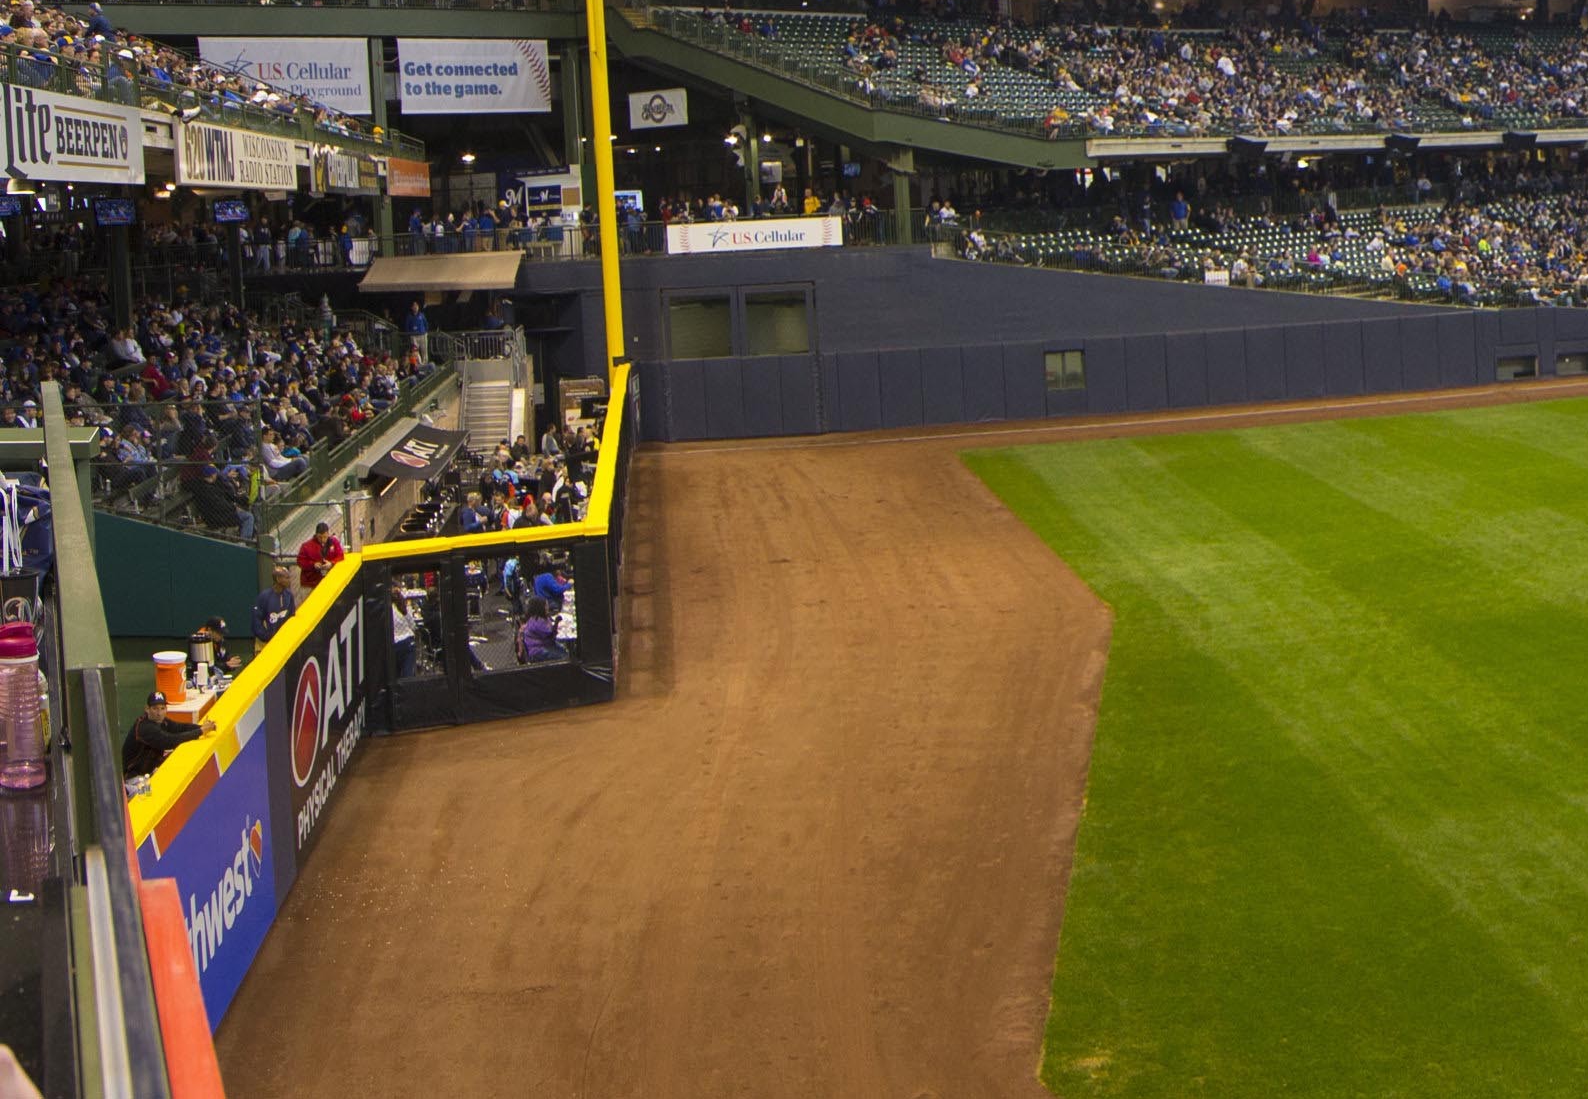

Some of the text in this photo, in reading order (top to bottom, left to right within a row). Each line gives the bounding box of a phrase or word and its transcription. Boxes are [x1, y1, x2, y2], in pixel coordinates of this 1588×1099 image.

[257, 62, 351, 81] U.S. Cellular
[404, 61, 518, 79] Get connected
[405, 82, 503, 99] to the game.
[54, 115, 118, 160] BEERPEN
[239, 160, 294, 185] RADIO STATION
[754, 230, 806, 243] Cellular
[321, 595, 364, 749] ATI
[298, 697, 367, 851] PHYSICAL THERAPY
